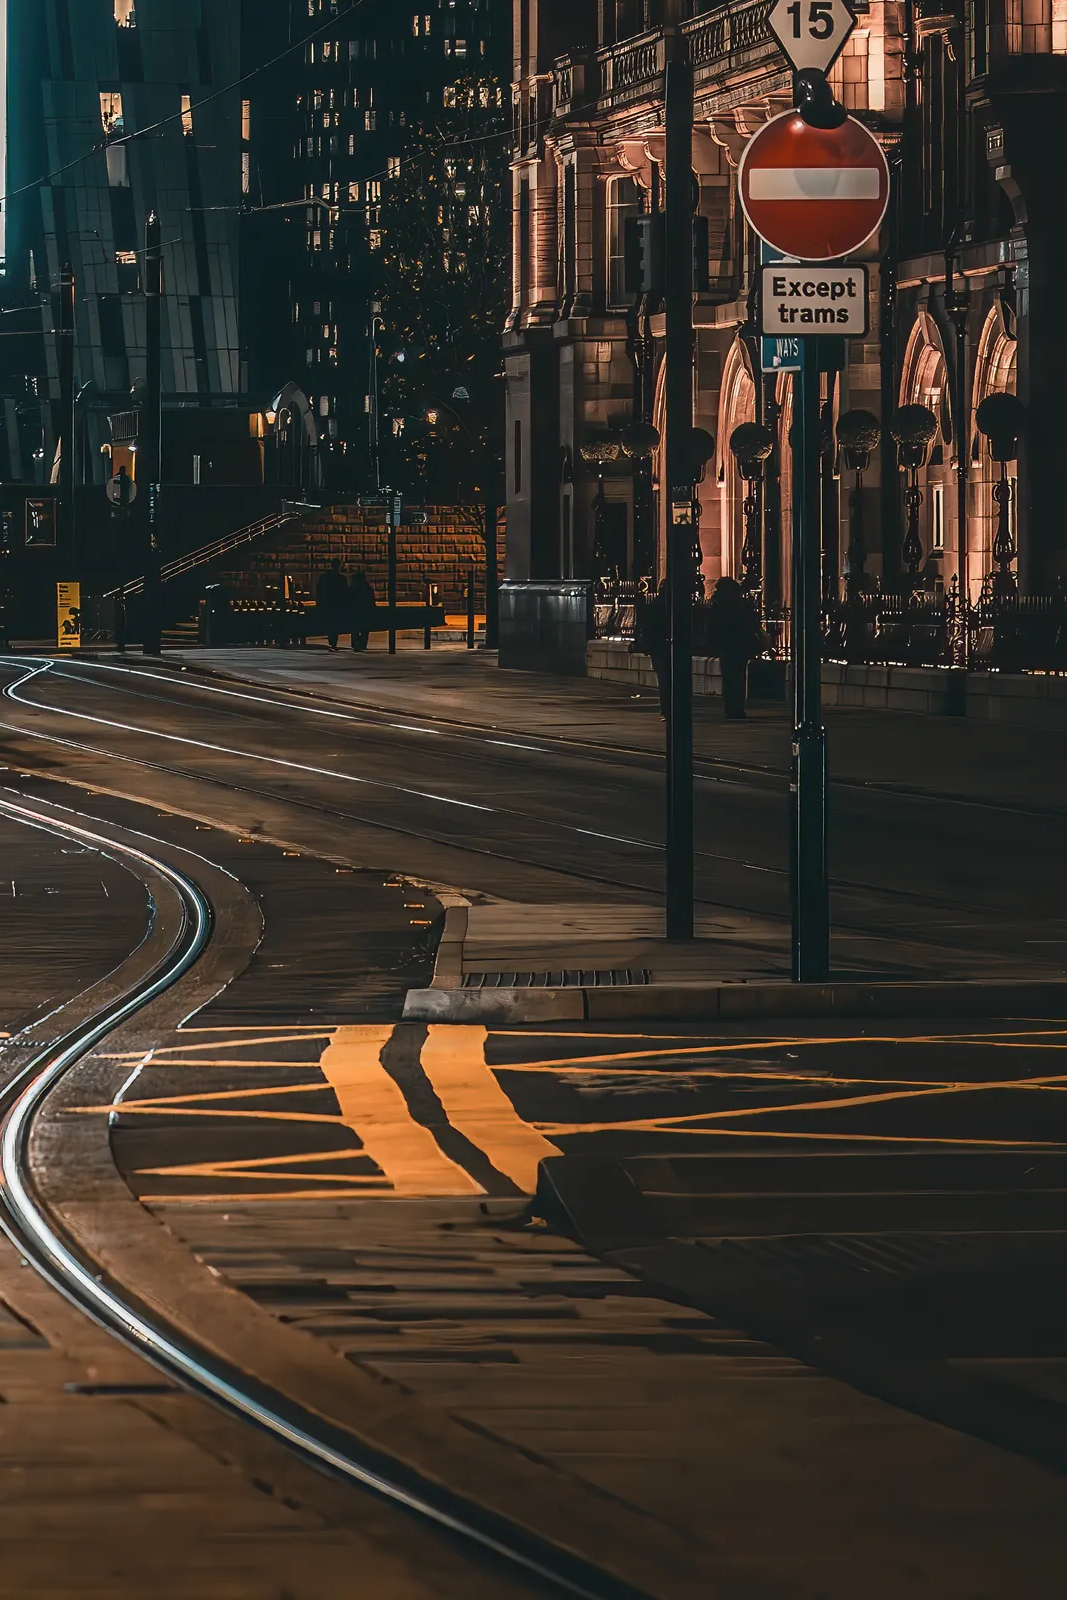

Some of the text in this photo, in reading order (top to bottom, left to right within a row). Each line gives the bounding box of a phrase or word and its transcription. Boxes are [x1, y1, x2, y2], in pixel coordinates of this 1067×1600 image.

[786, 1, 835, 40] 15
[772, 277, 856, 301] Except
[778, 304, 849, 324] trams
[775, 338, 799, 357] WAYS
